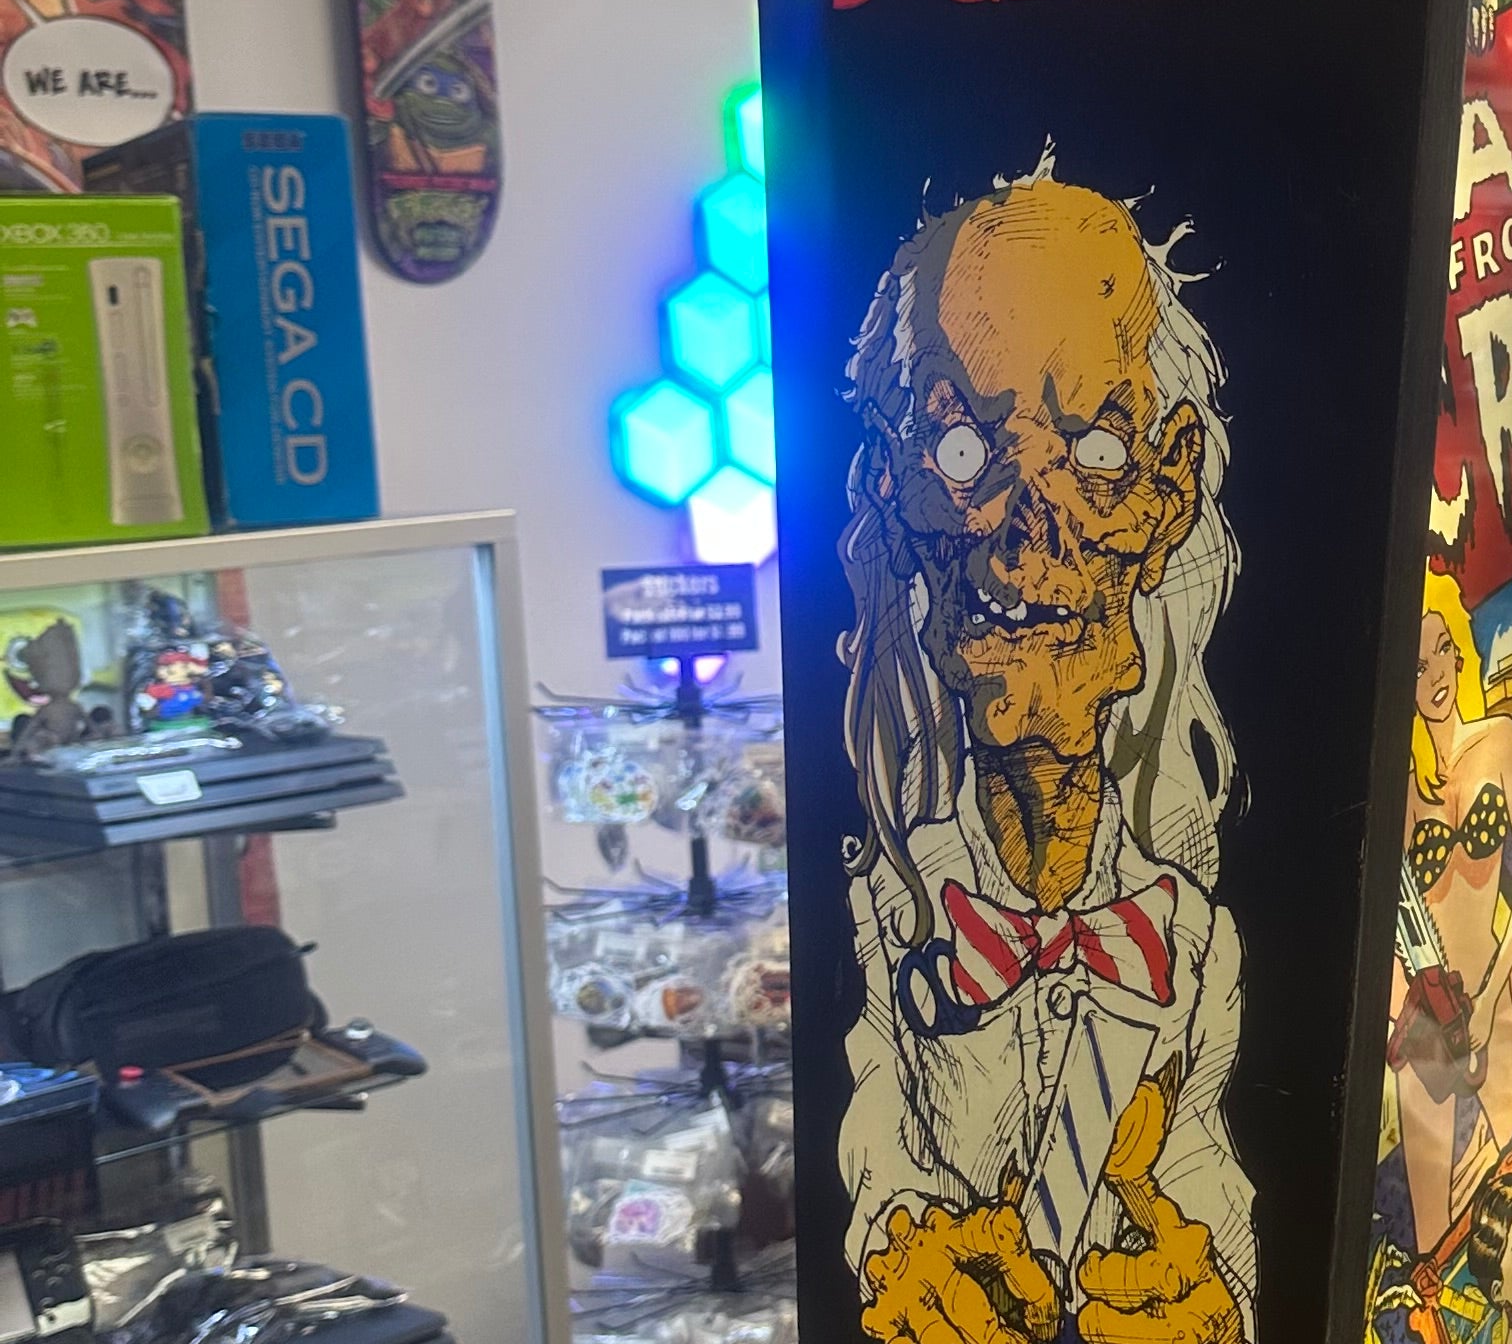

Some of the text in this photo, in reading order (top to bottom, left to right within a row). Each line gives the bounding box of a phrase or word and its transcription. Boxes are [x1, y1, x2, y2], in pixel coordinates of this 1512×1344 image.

[24, 67, 68, 96] WE
[262, 164, 319, 364] SEGA
[281, 378, 330, 487] CD
